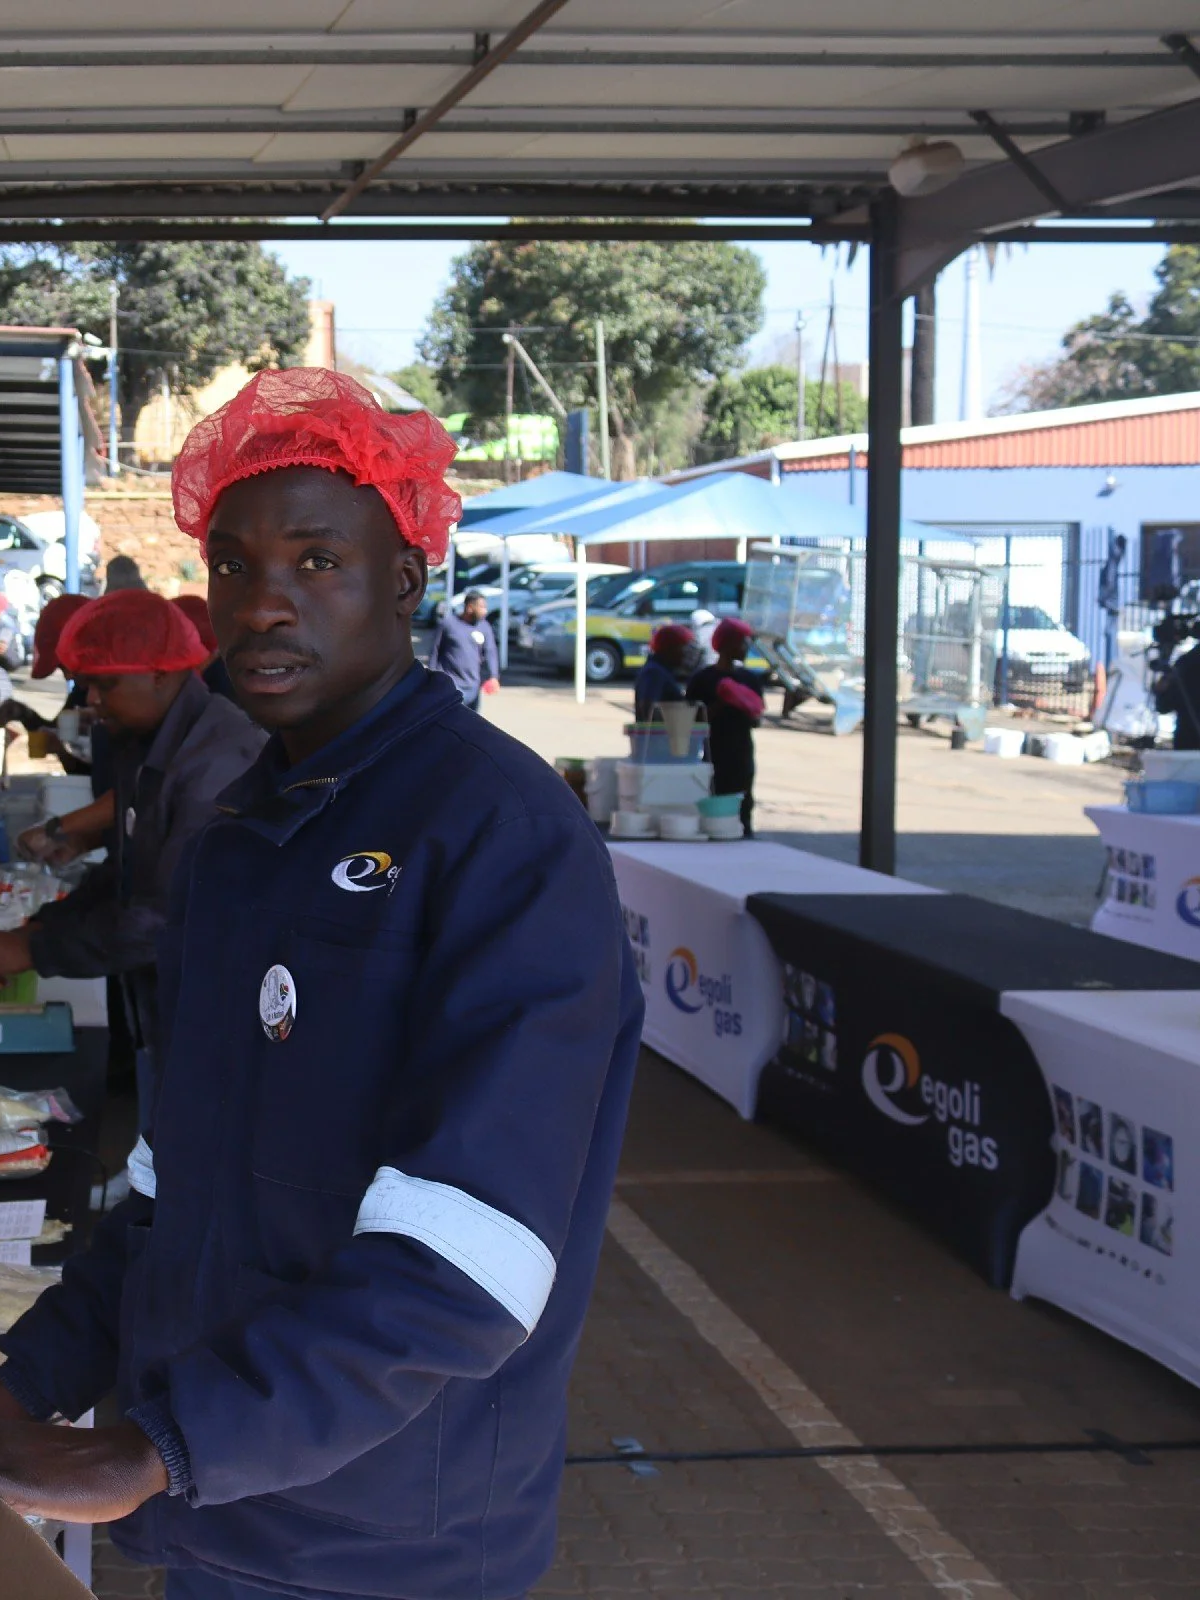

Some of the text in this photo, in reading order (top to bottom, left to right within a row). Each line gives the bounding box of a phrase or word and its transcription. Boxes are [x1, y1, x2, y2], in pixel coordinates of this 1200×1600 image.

[714, 1007, 743, 1037] gas
[920, 1074, 981, 1127] egoli
[948, 1125, 1000, 1171] gas
